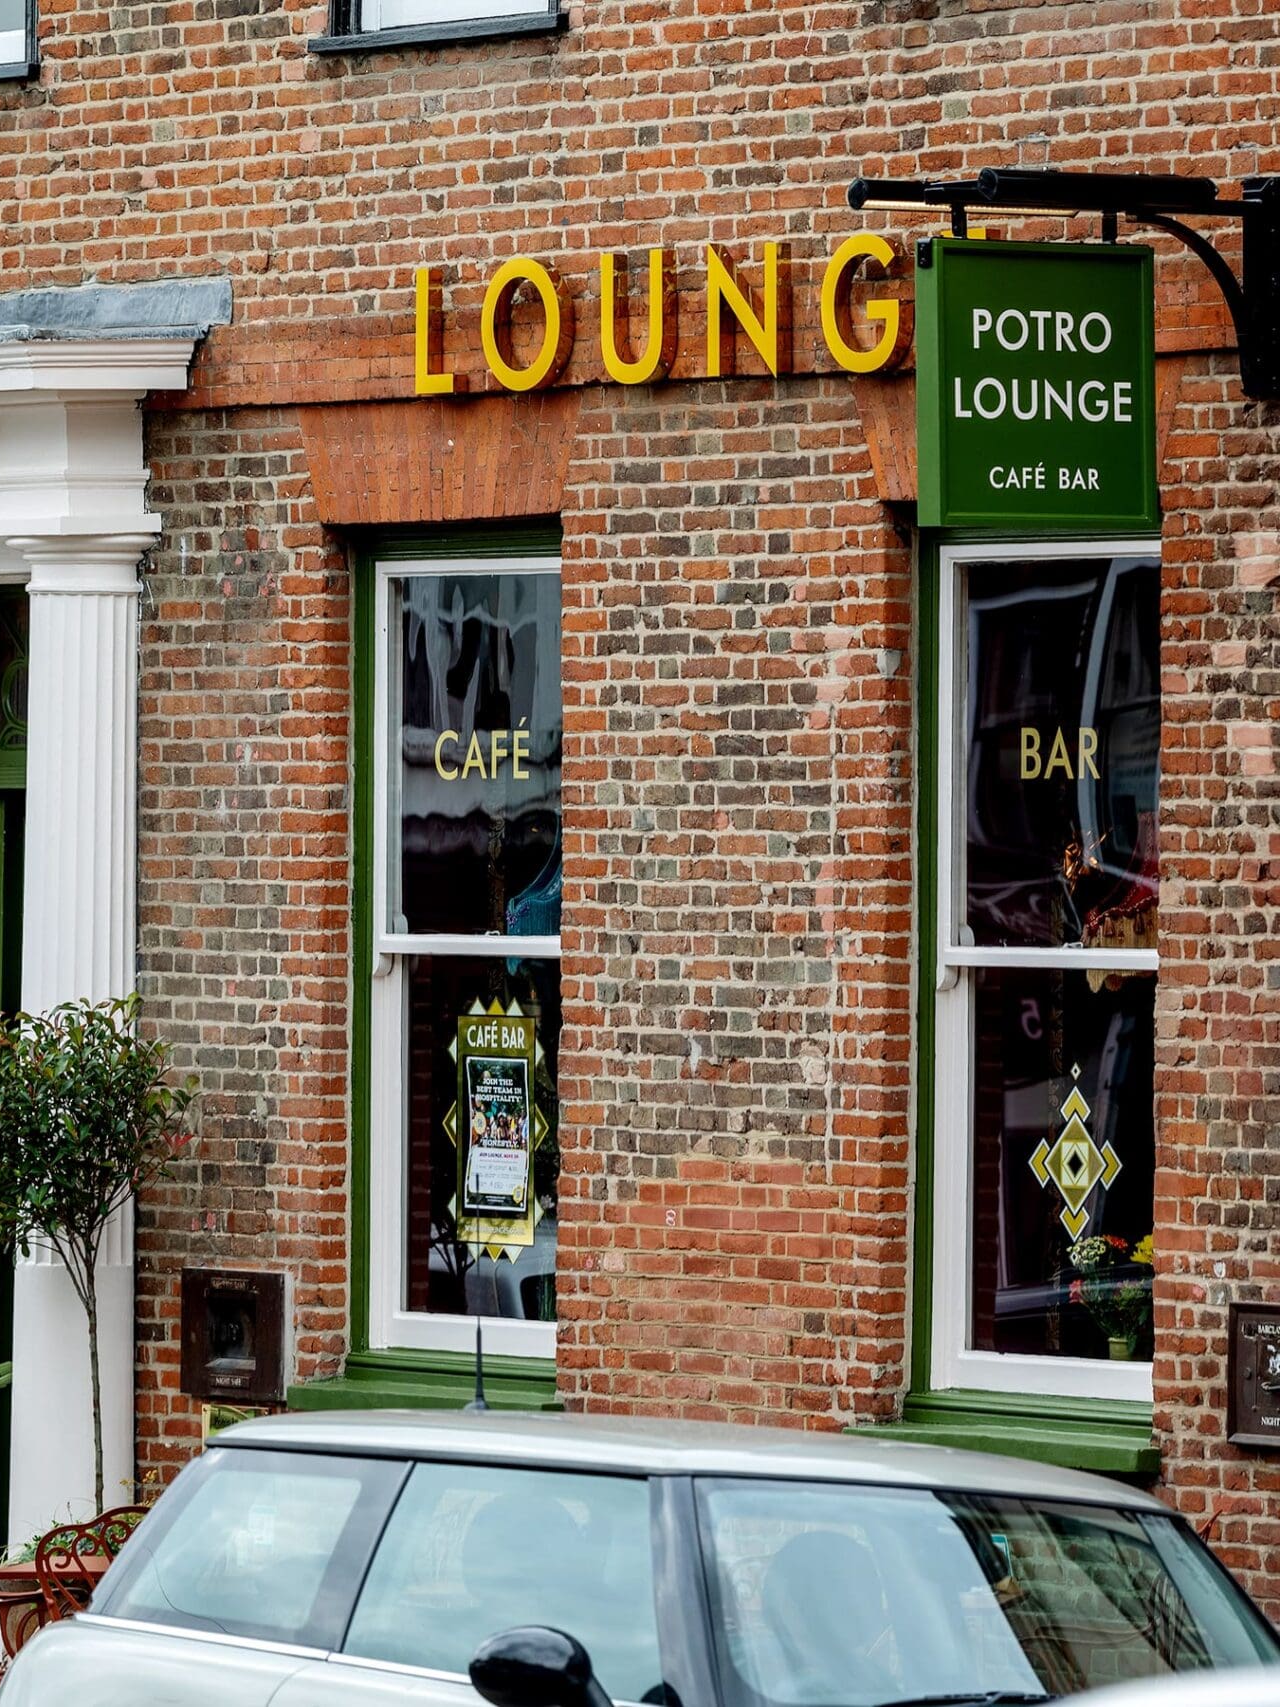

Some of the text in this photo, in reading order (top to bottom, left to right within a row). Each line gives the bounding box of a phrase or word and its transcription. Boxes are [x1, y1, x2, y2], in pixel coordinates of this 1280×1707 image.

[415, 228, 987, 395] LOUNG
[972, 308, 1113, 354] POTRO
[954, 377, 1133, 423] LOUNGE
[988, 462, 1101, 491] CAFÉ BAR
[434, 716, 530, 781] CAFÉ
[1020, 726, 1101, 780] BAR
[466, 1020, 525, 1049] CAFÉ BAR
[482, 1078, 513, 1086] JOIN THE
[493, 1086, 513, 1094] TEAM
[514, 1087, 522, 1095] IN
